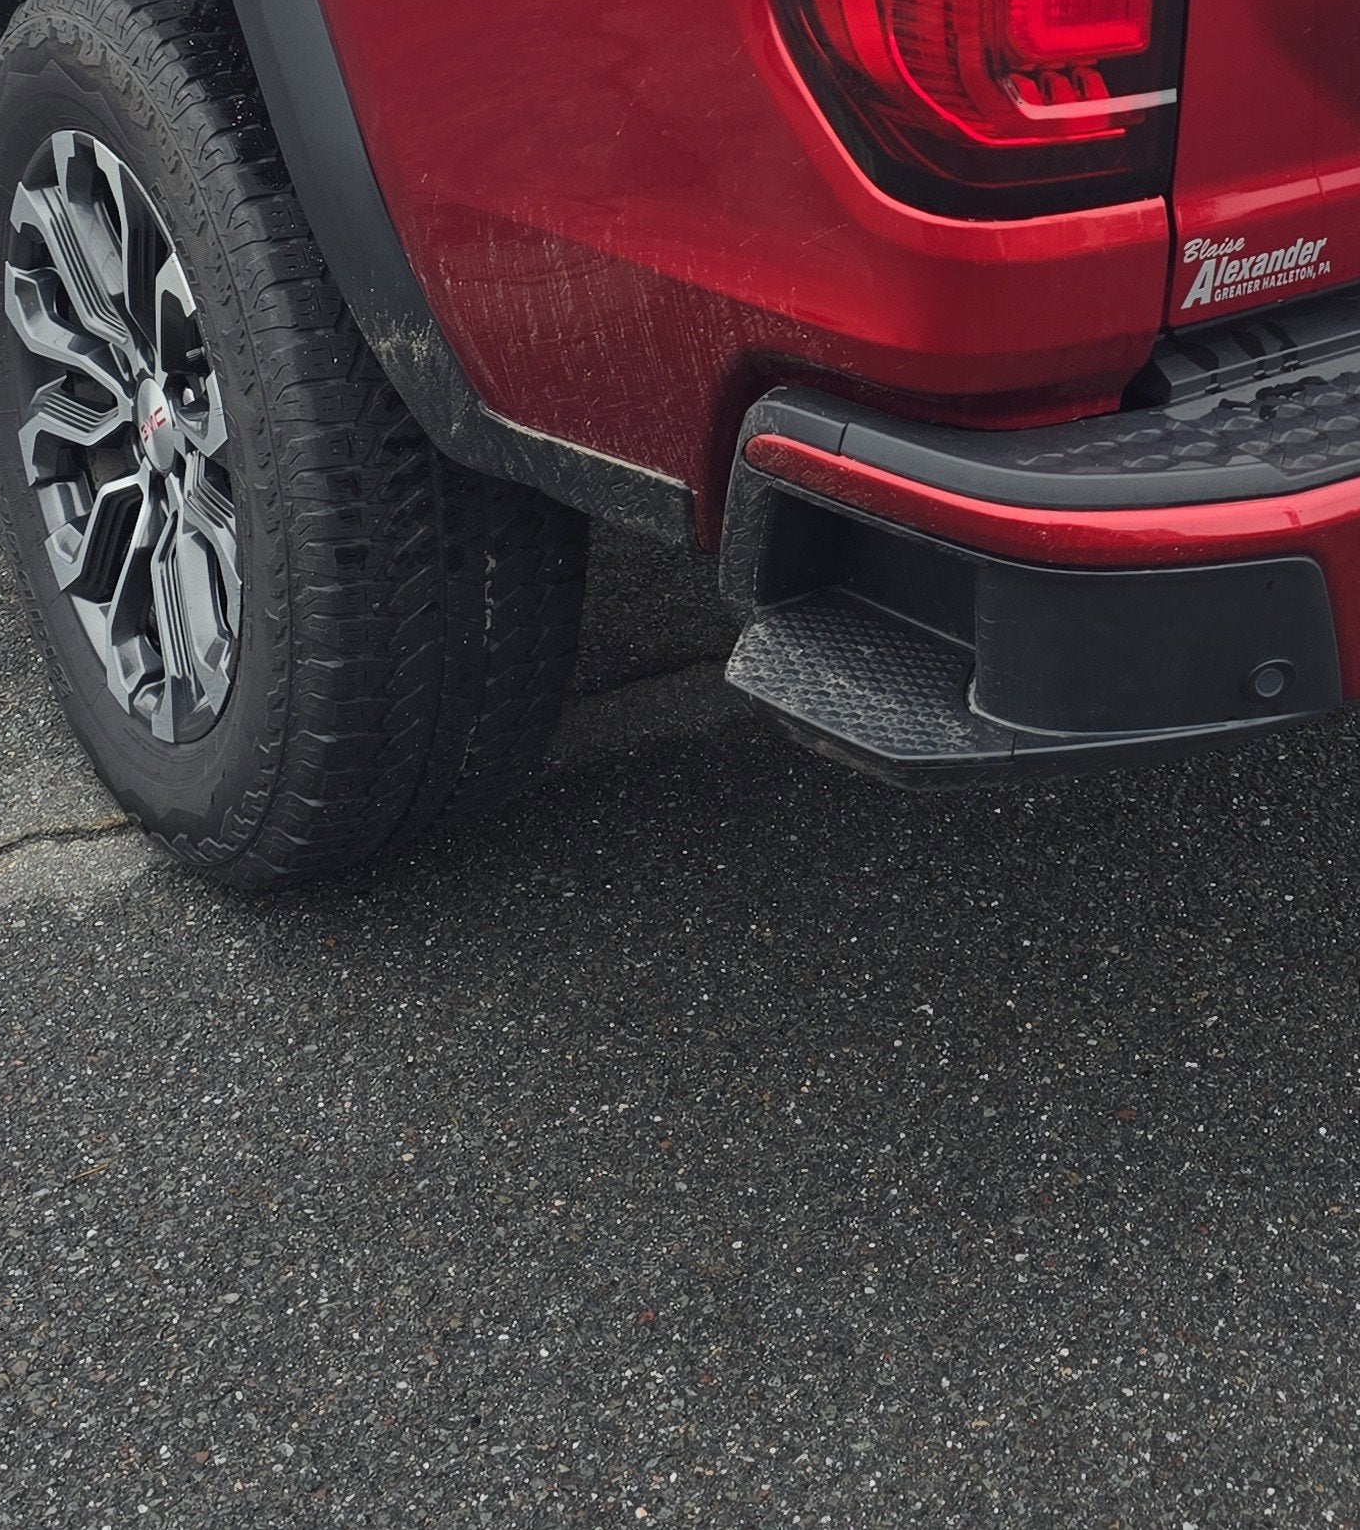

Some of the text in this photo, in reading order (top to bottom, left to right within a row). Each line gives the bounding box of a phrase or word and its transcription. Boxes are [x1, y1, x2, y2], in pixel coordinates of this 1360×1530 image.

[1183, 237, 1246, 264] Blaise
[1180, 236, 1328, 310] Alexander
[1213, 260, 1331, 303] GREATER HAZLETON, PA
